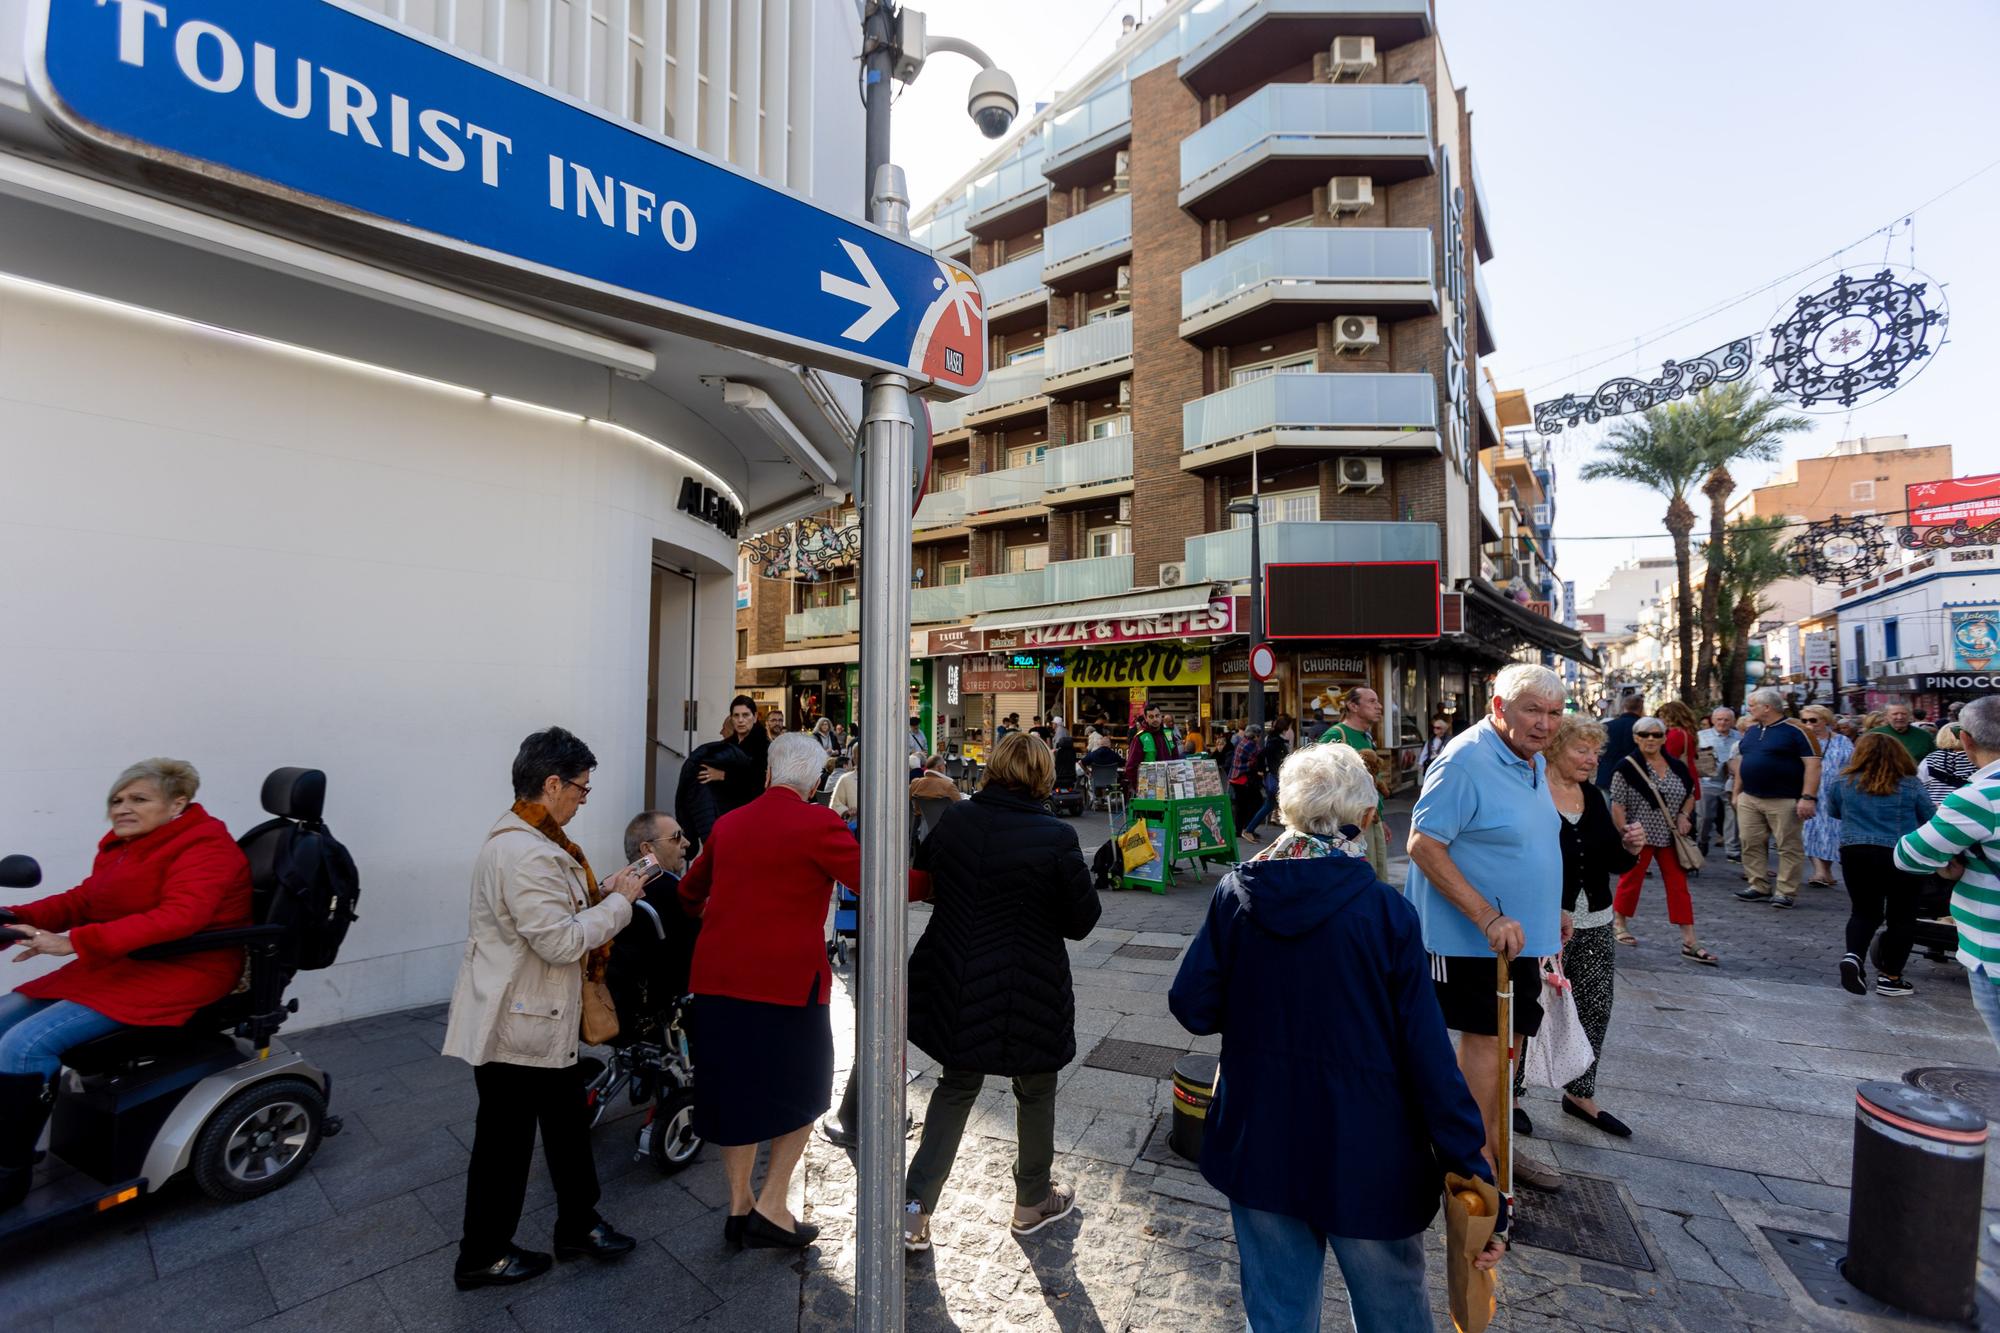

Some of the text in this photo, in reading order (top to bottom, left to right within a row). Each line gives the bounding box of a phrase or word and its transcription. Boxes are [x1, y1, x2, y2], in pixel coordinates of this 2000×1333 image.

[97, 0, 698, 253] TOURIST INFO
[945, 348, 963, 375] NASER
[1024, 601, 1229, 645] PIZZA & CREPES
[1014, 656, 1034, 665] PIZZA
[1071, 645, 1184, 683] ABIERTO
[1303, 655, 1364, 673] CHURRERÍA
[966, 680, 1017, 690] STREET FOOD
